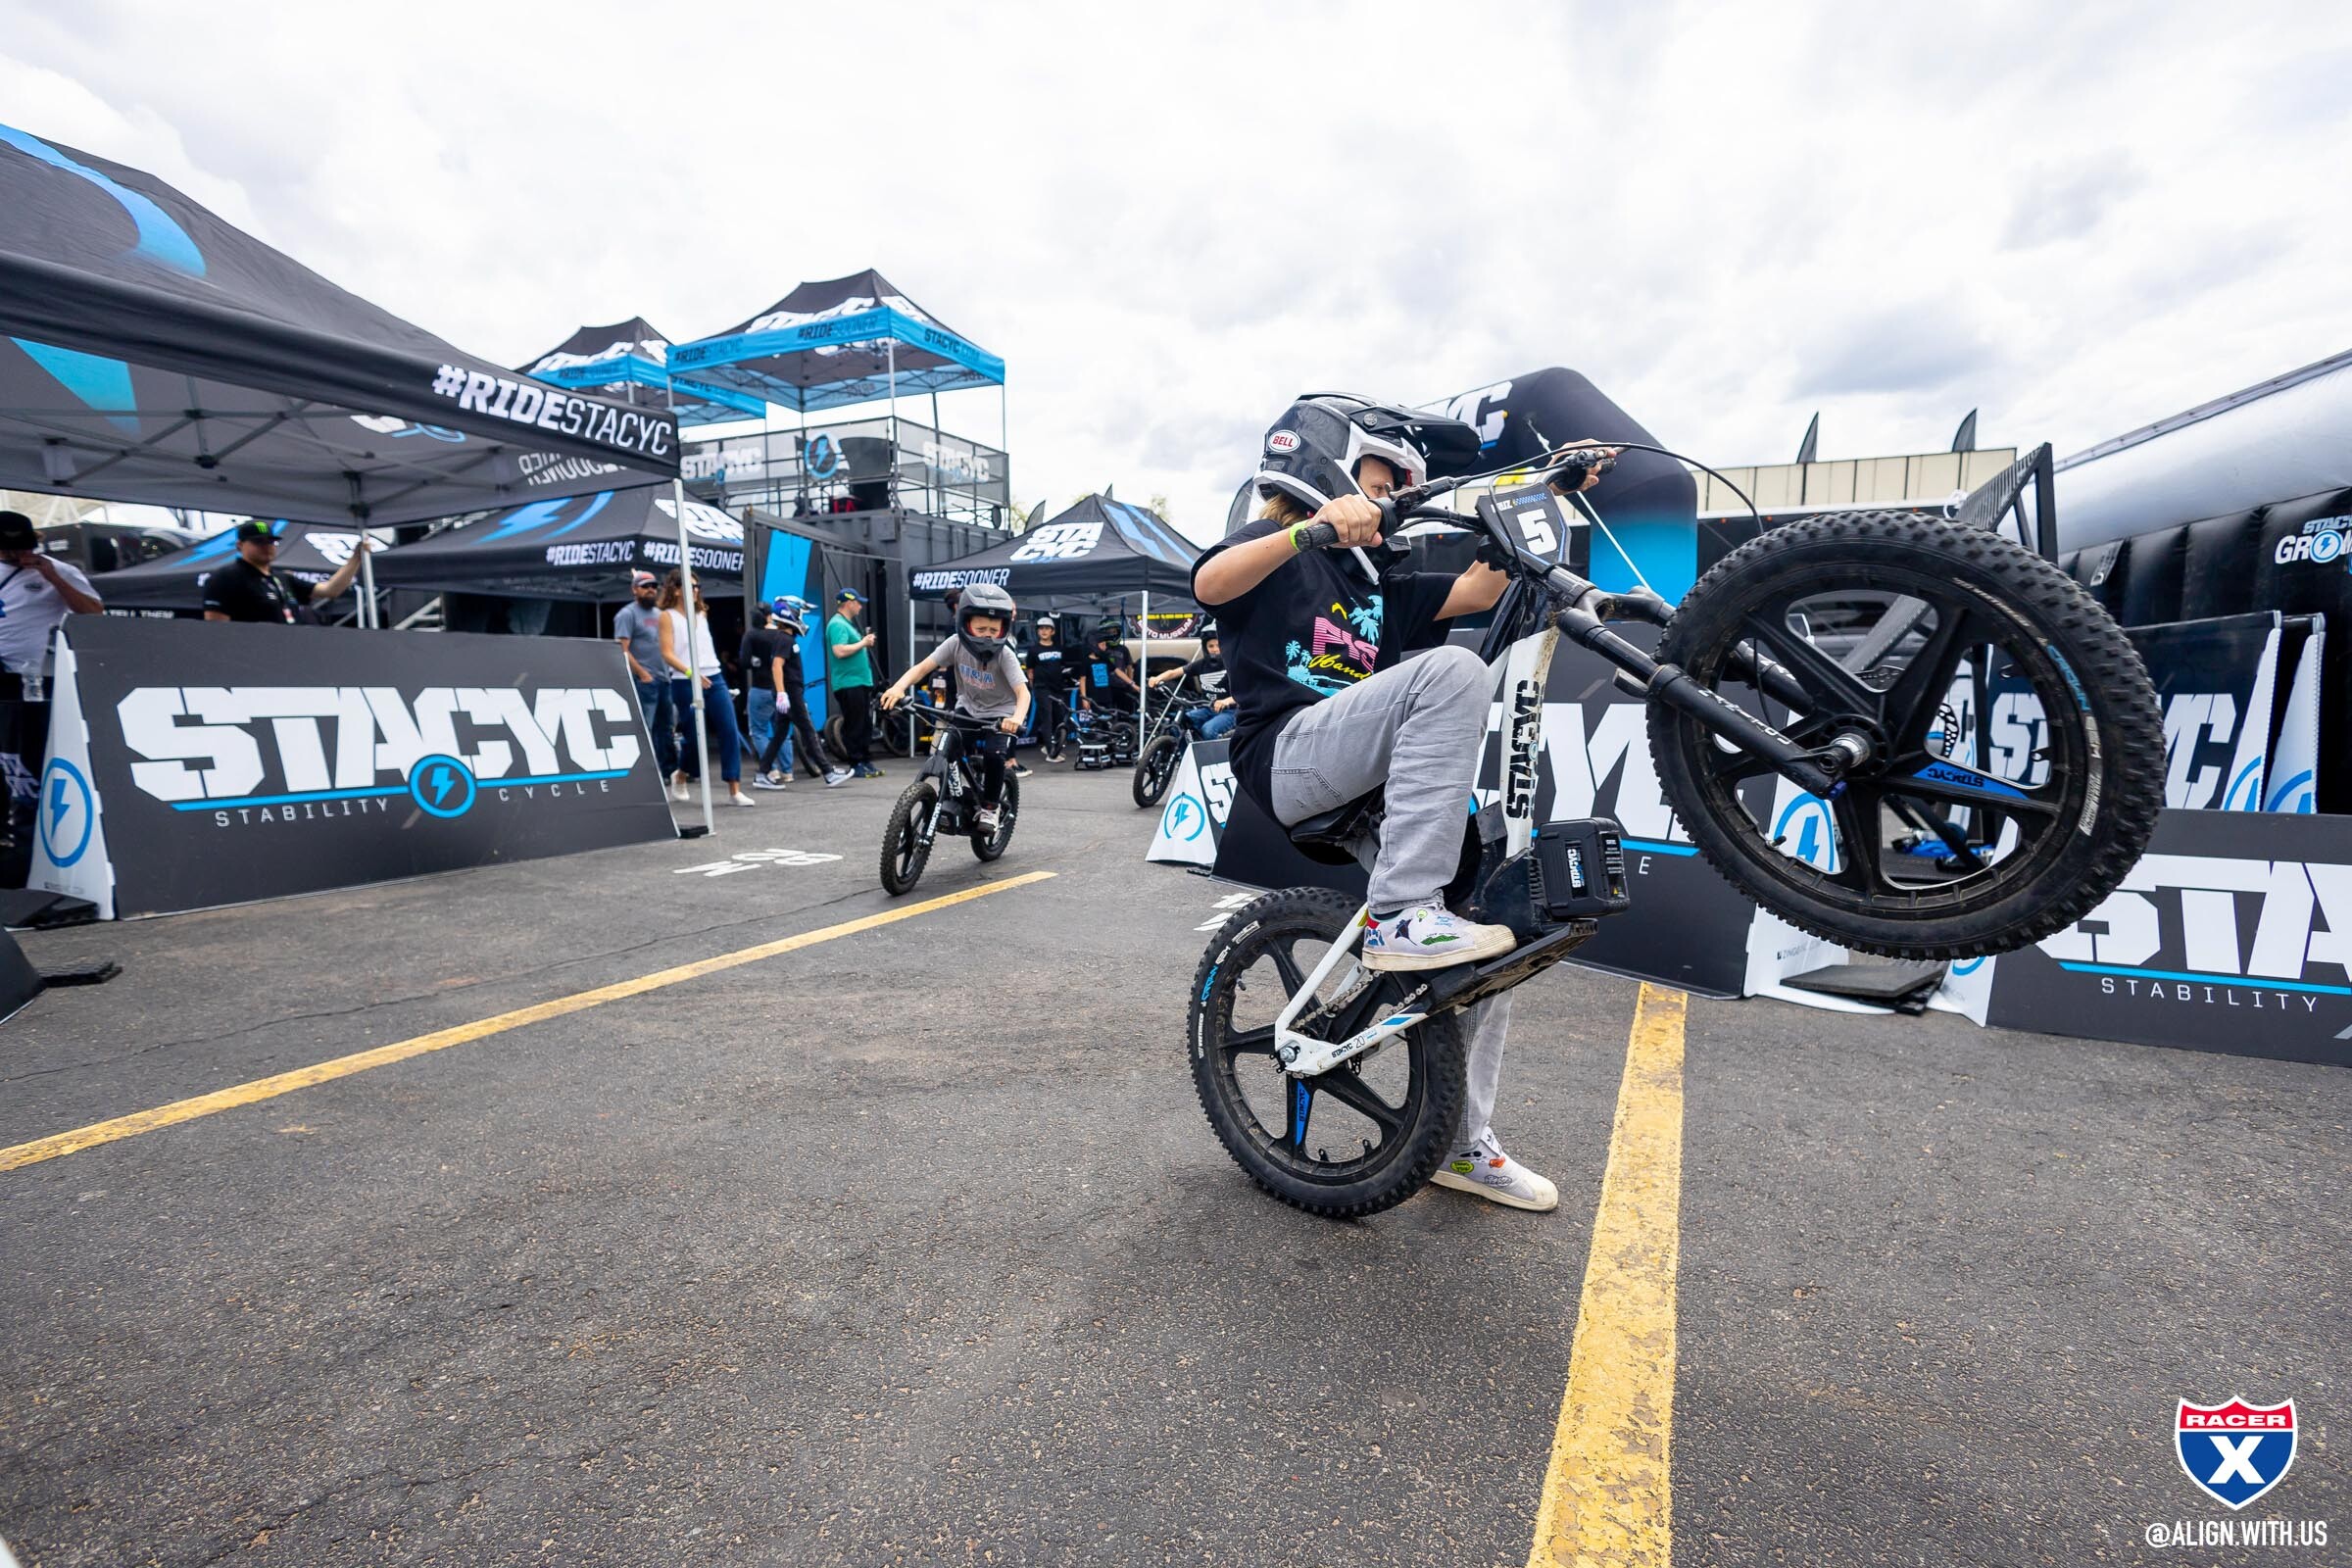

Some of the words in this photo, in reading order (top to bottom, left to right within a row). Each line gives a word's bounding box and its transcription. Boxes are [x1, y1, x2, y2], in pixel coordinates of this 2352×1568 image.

[431, 364, 672, 456] #RIDESTACYC
[1273, 434, 1294, 448] BELL
[1517, 508, 1557, 556] 5
[546, 540, 635, 566] #RIDESTACYC
[912, 567, 1010, 590] #RIDESOONER
[117, 686, 642, 802] STACYC
[216, 798, 388, 828] STABILITY
[498, 779, 611, 803] CYCLE
[2101, 976, 2317, 1013] STABILITY
[1353, 1035, 1366, 1049] 20
